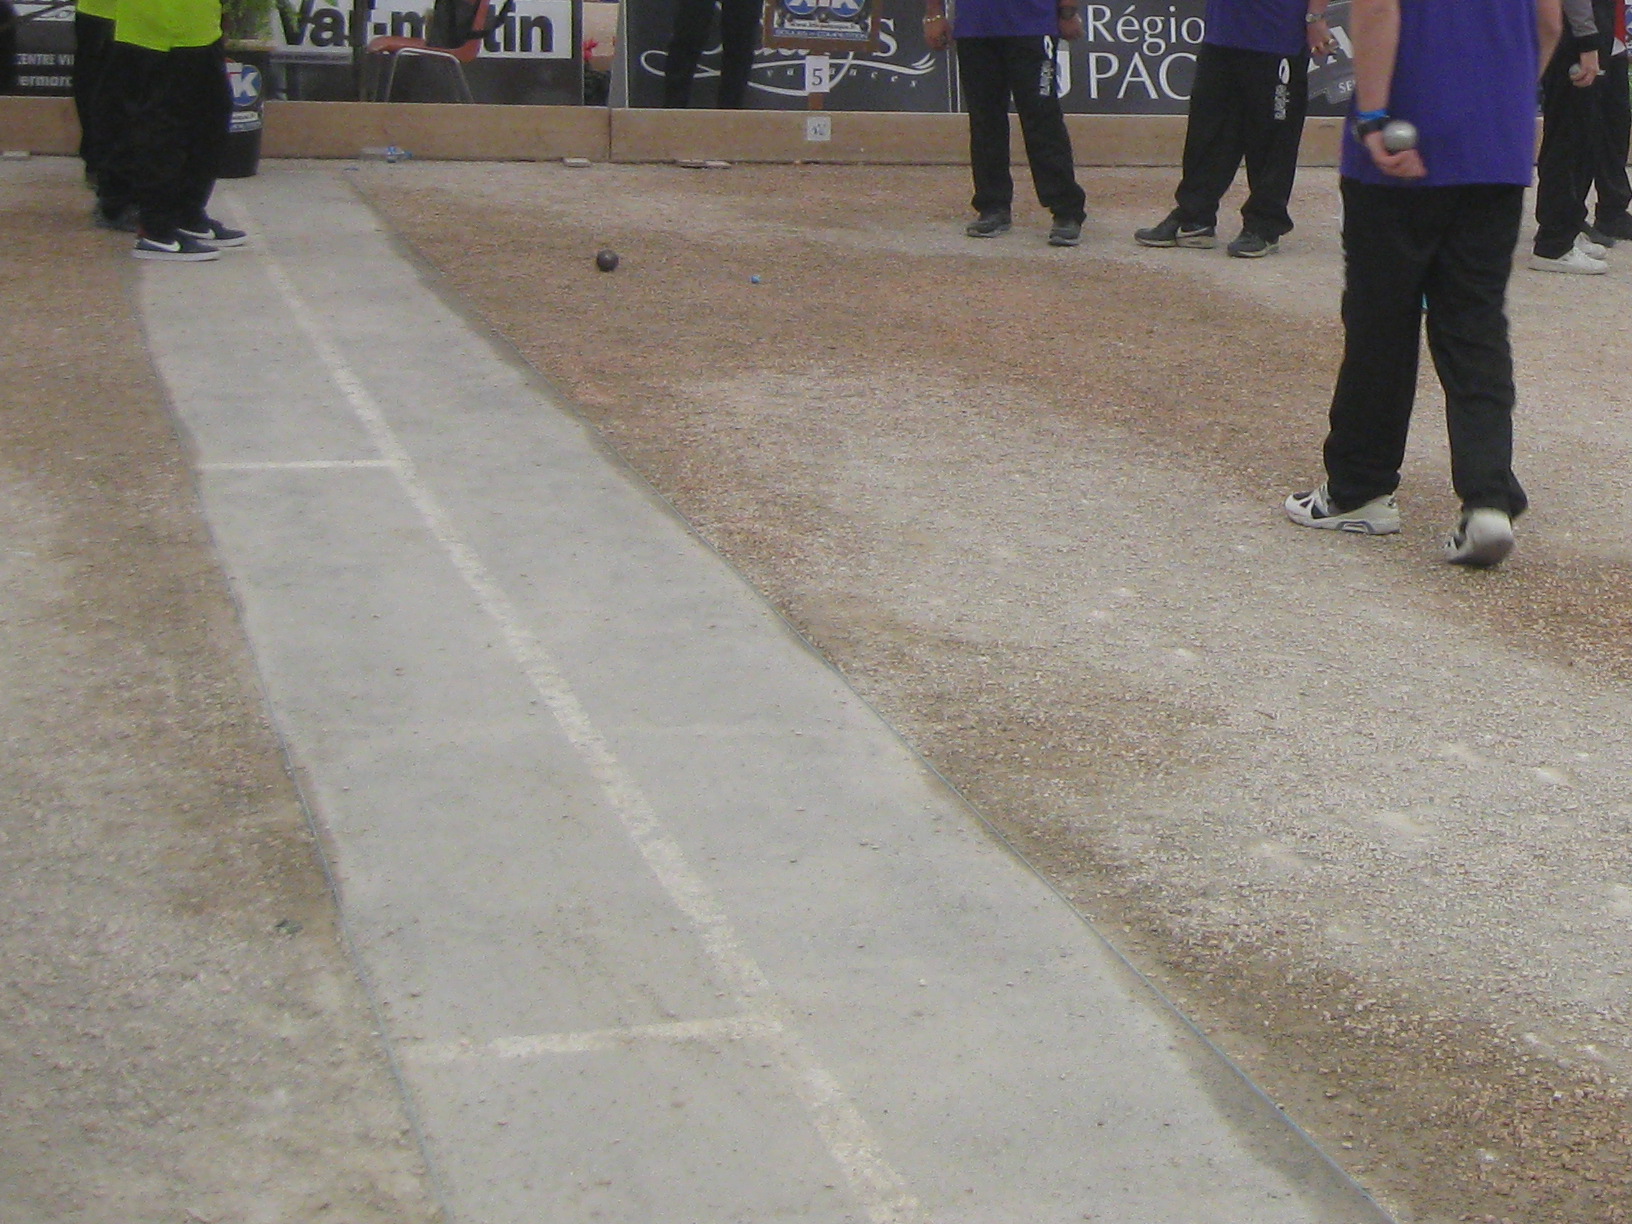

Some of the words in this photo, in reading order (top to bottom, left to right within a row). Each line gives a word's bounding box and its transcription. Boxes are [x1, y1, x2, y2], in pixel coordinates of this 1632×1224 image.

[1086, 4, 1206, 57] Régio
[810, 68, 823, 87] 5
[1088, 51, 1198, 101] PAC
